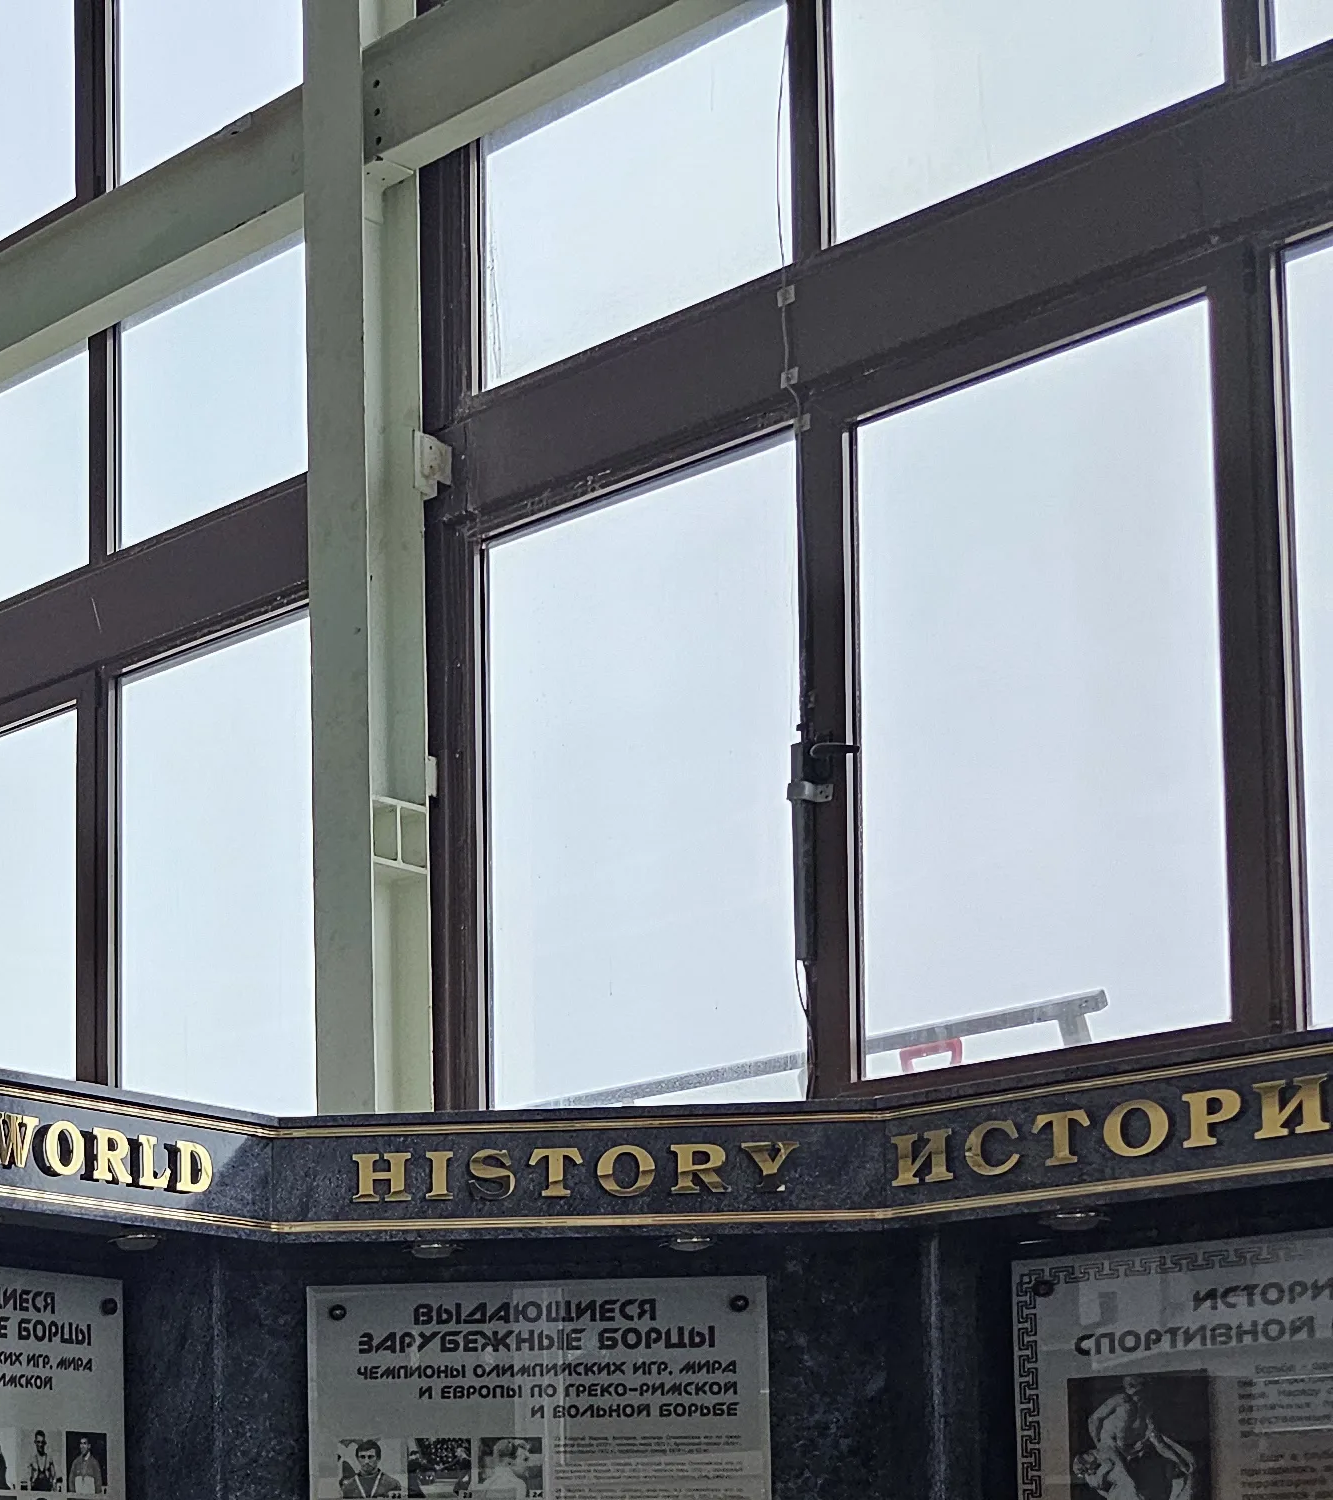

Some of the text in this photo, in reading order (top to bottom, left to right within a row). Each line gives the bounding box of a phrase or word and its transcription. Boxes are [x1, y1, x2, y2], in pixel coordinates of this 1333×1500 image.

[892, 1074, 1333, 1187] ИСТОРИ
[353, 1141, 799, 1201] HISTORY
[413, 1298, 657, 1326] ВЫДАЮЩИЕСЯ
[17, 1318, 92, 1346] БОРЦЫ
[357, 1324, 716, 1355] ЗАРУБЕЖНЫЕ БОРЦЫ
[1074, 1315, 1315, 1356] СПОРТИВНОЙ
[56, 1356, 93, 1372] МИРА
[356, 1362, 466, 1381] ЧЕМПИОНЫ
[472, 1361, 627, 1379] ОЛИМПИЙСКИХ
[679, 1359, 737, 1375] МИРА
[418, 1380, 739, 1400] И ЕВРОПЫ ПО ГРЕКО-РИМСКОЙ
[530, 1402, 739, 1419] И ВОЛЬНОЙ БОРЬБЕ
